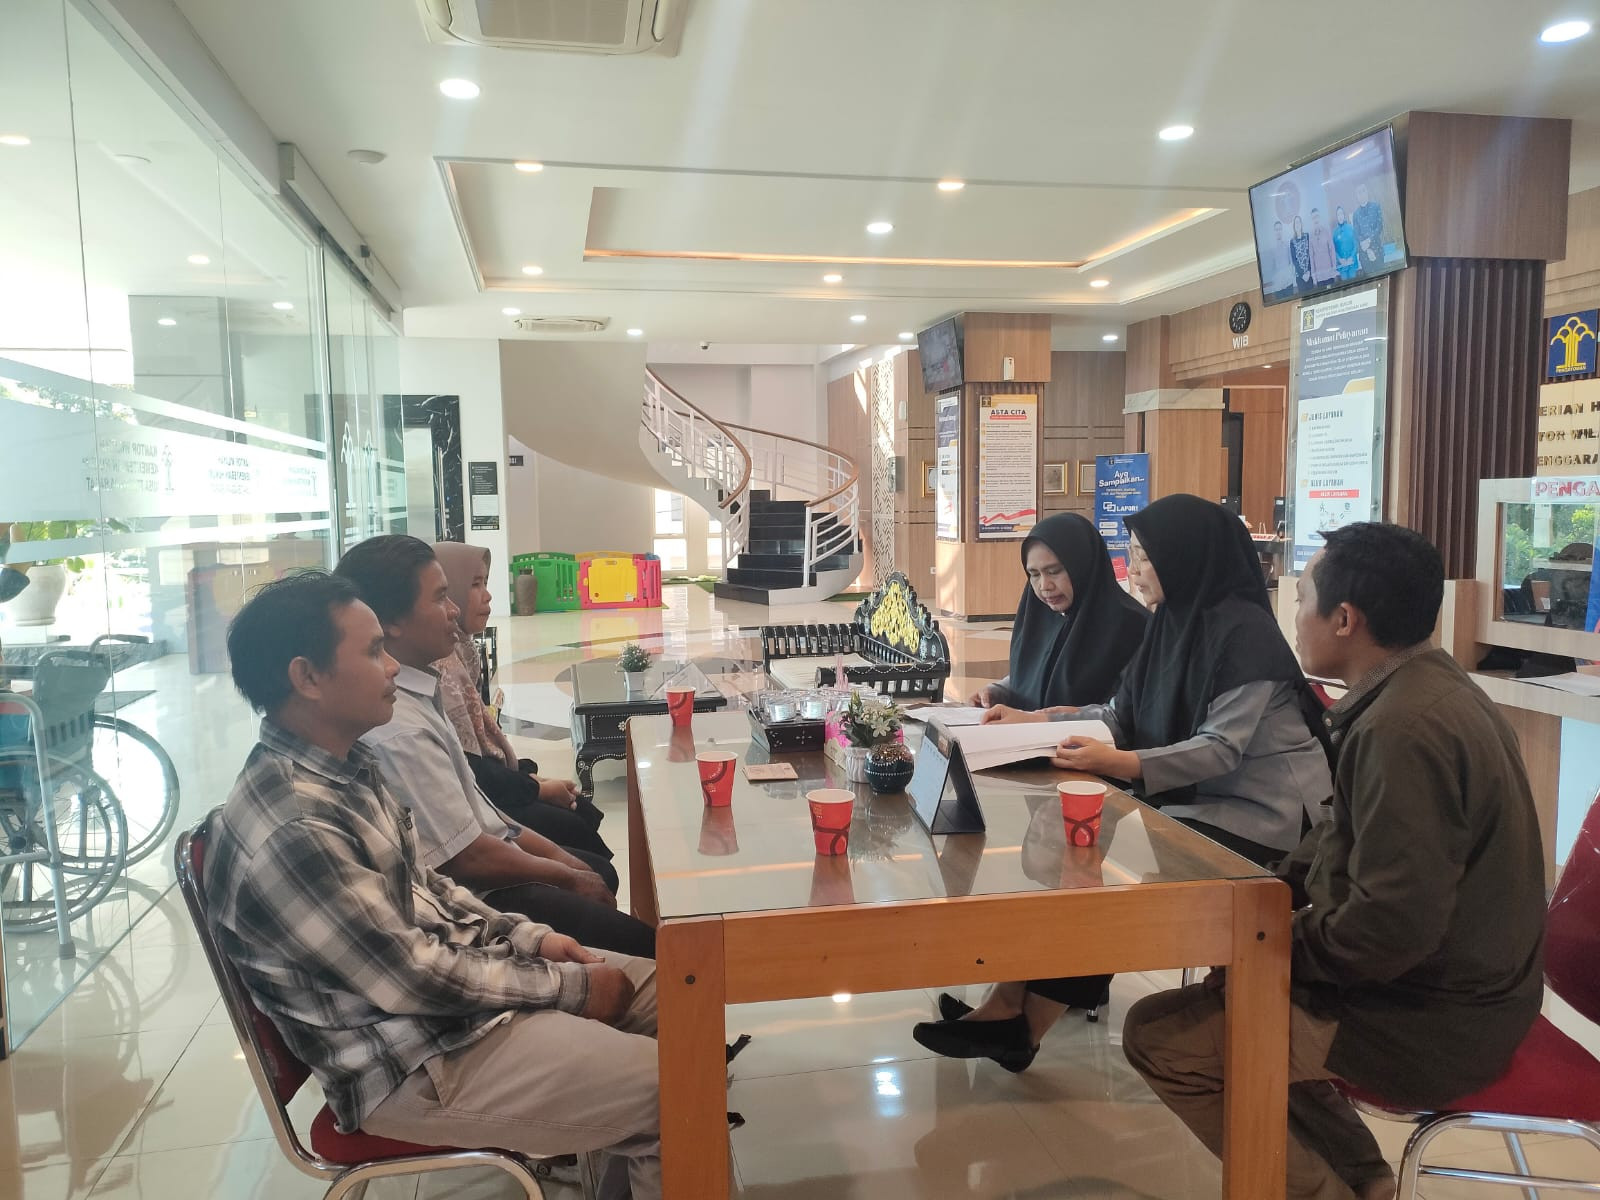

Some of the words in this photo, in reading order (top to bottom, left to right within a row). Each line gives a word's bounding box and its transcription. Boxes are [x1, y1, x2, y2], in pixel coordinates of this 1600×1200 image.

[1232, 334, 1249, 350] WIB
[1306, 334, 1335, 346] Maklumat
[1335, 327, 1369, 341] Pelayanan
[1571, 427, 1600, 440] WIL
